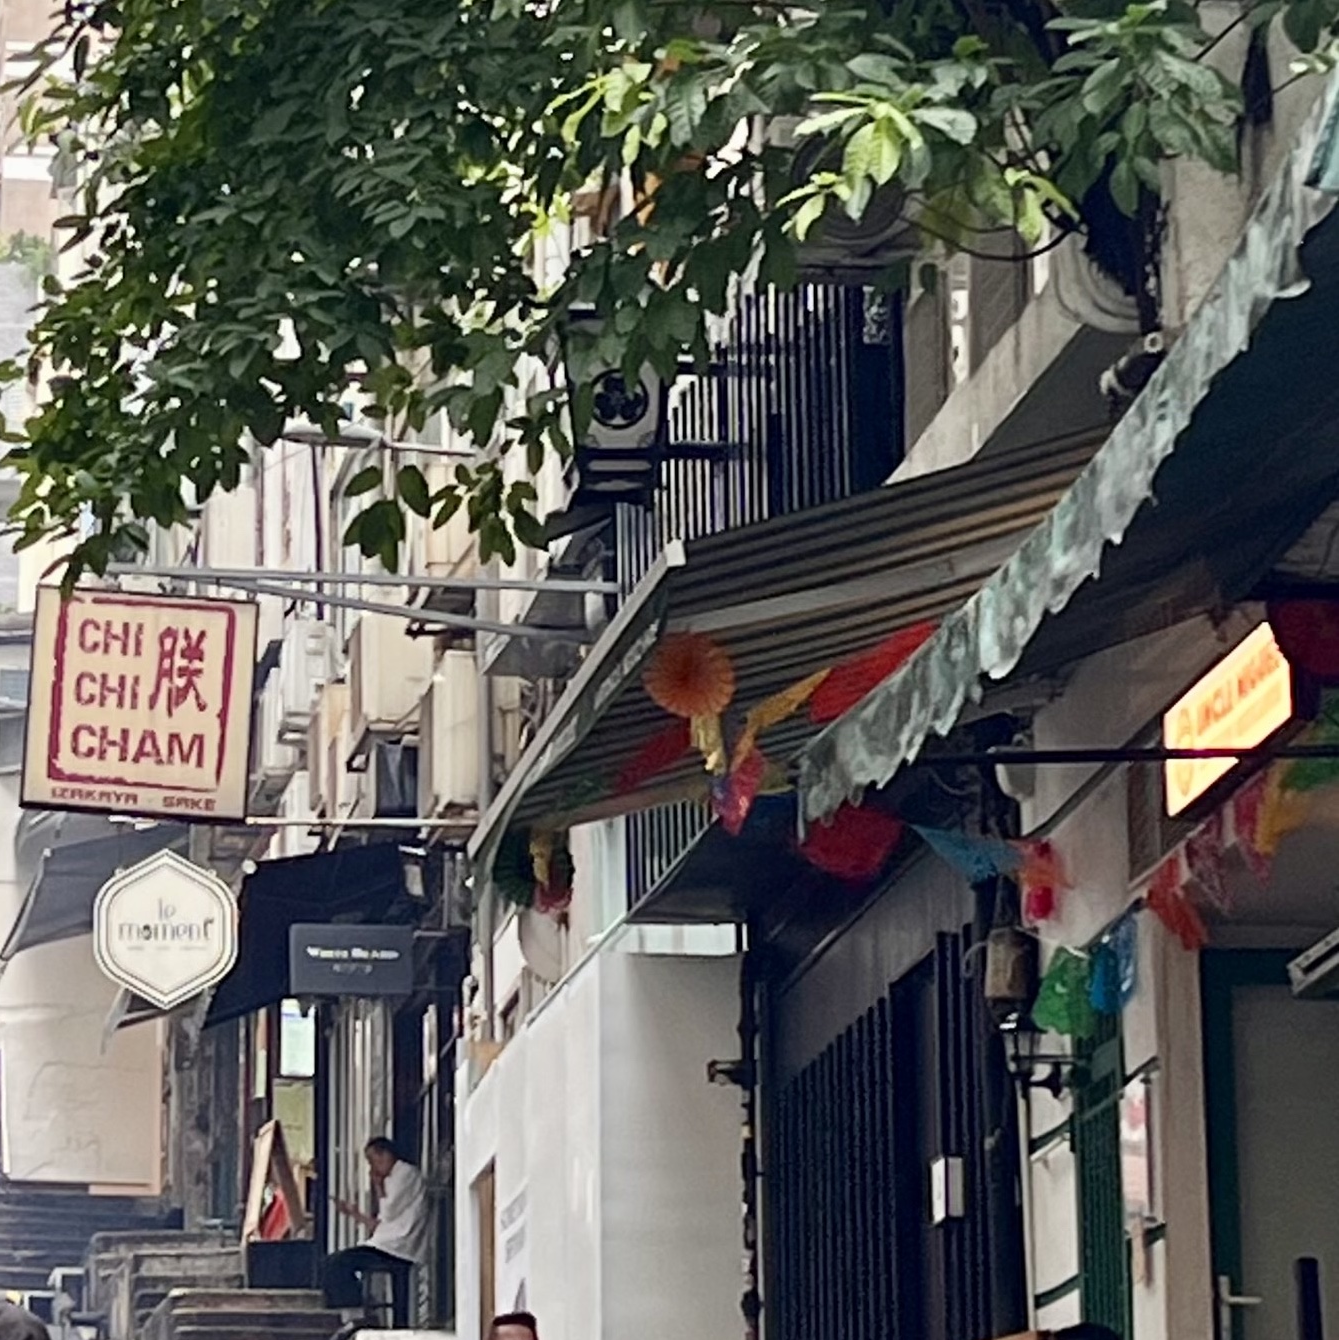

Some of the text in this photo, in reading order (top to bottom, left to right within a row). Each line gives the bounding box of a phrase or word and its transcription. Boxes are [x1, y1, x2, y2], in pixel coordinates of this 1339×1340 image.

[78, 618, 144, 657] CHI
[74, 671, 140, 710] CHI
[70, 723, 205, 769] CHAM
[51, 787, 216, 812] IZAKAYA SAKE
